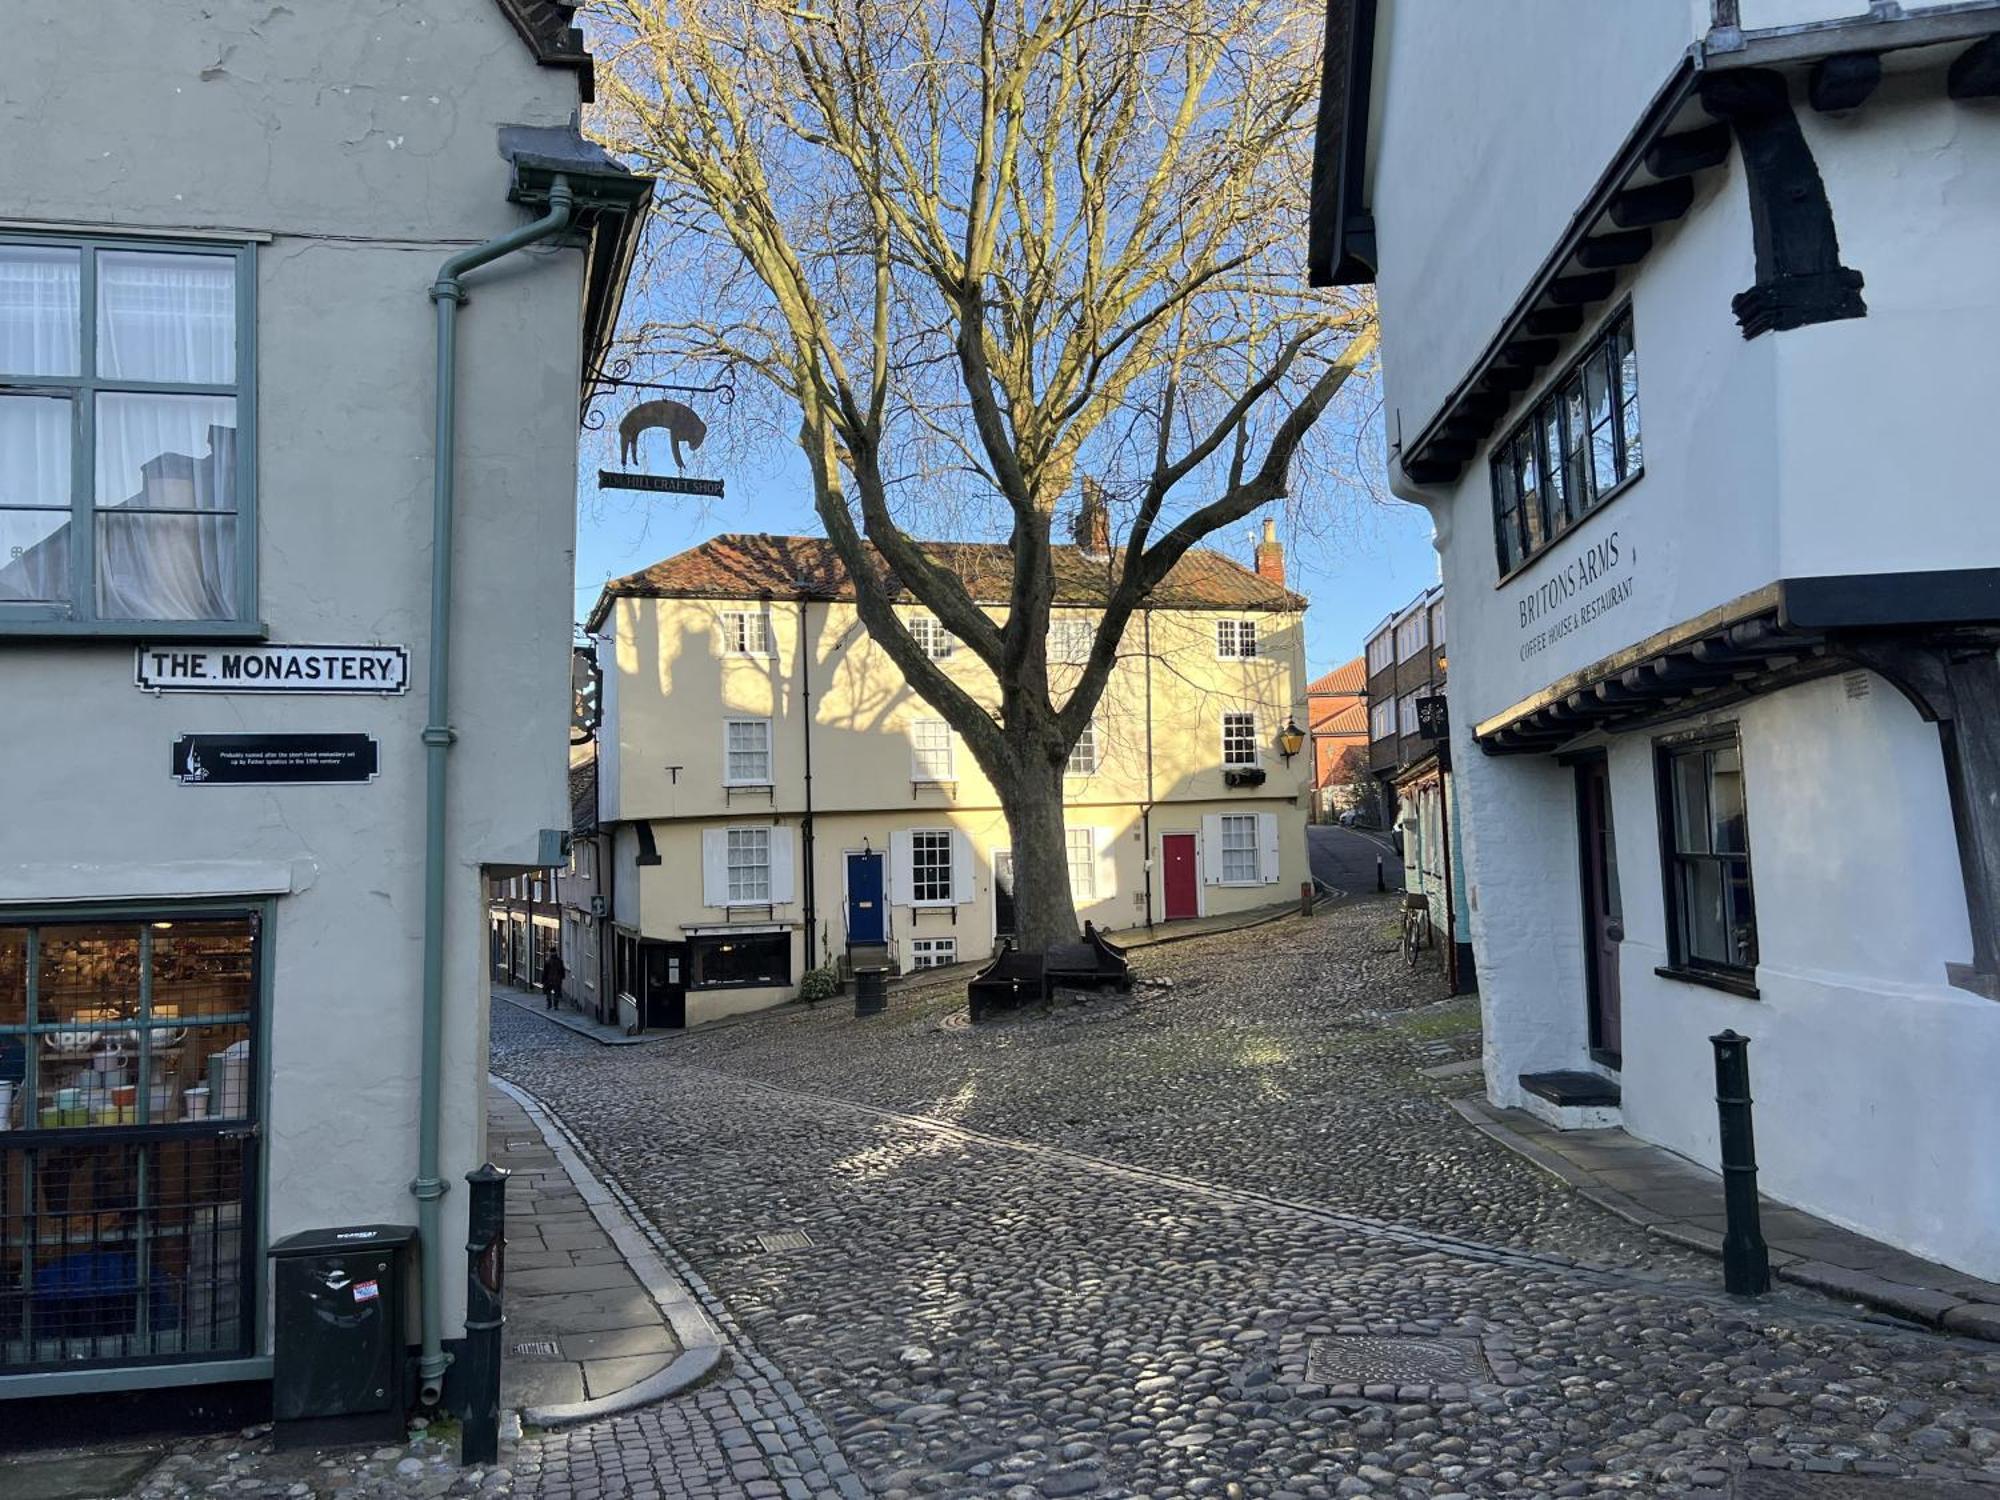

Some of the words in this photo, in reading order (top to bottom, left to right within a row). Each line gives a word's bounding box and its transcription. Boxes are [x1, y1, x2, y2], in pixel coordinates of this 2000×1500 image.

[626, 476, 651, 490] HILL
[654, 478, 689, 492] CRAFT
[692, 481, 721, 494] SHOP
[1519, 565, 1576, 628] BRITONS
[1579, 531, 1620, 591] ARMS
[1519, 632, 1547, 662] COFFEE
[1548, 615, 1573, 646] HOUSE
[1572, 613, 1580, 629] &
[1580, 576, 1634, 626] RESTAURANT
